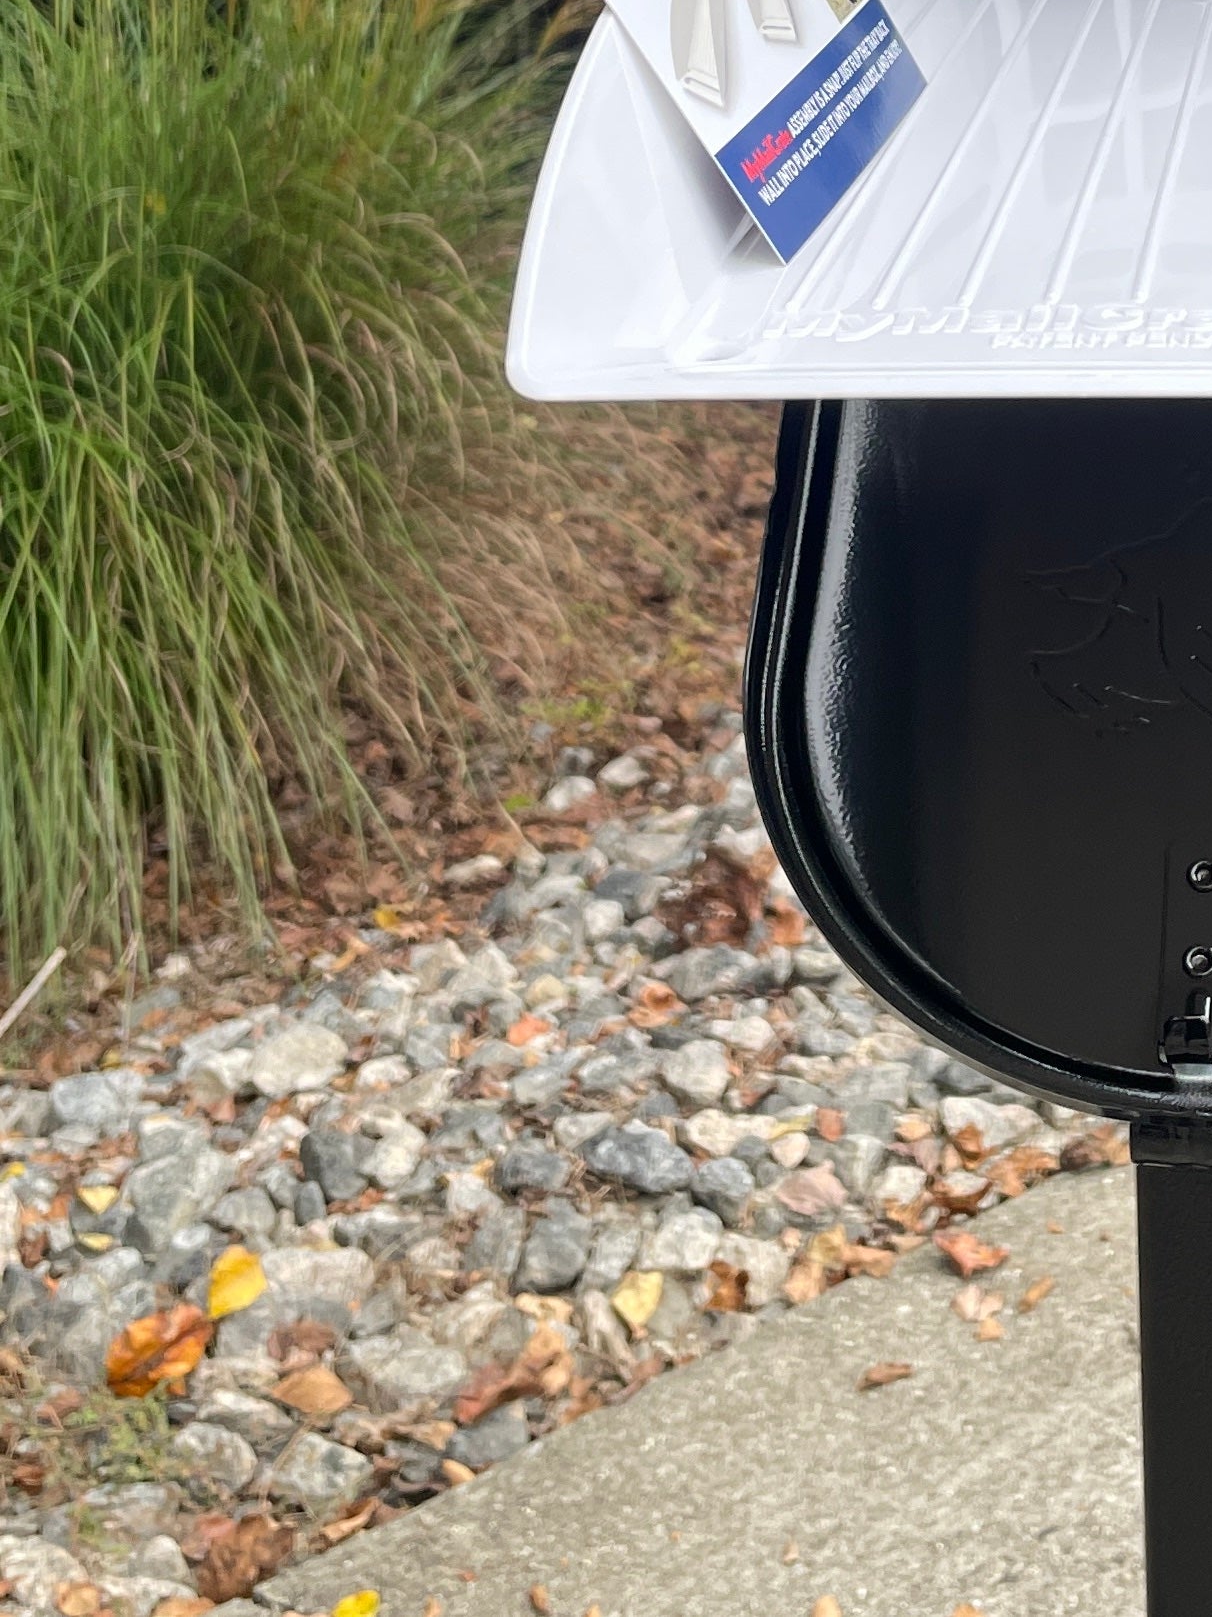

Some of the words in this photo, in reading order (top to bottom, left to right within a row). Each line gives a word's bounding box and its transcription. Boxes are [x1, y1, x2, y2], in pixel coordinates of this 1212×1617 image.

[831, 99, 851, 126] INTO
[842, 85, 864, 113] YOUR
[786, 92, 820, 138] ASSEMBLY
[826, 112, 839, 132] IT
[811, 118, 834, 150] SLIDE
[793, 137, 822, 173] PLACE,
[776, 158, 799, 187] INTO
[758, 175, 784, 207] WALL
